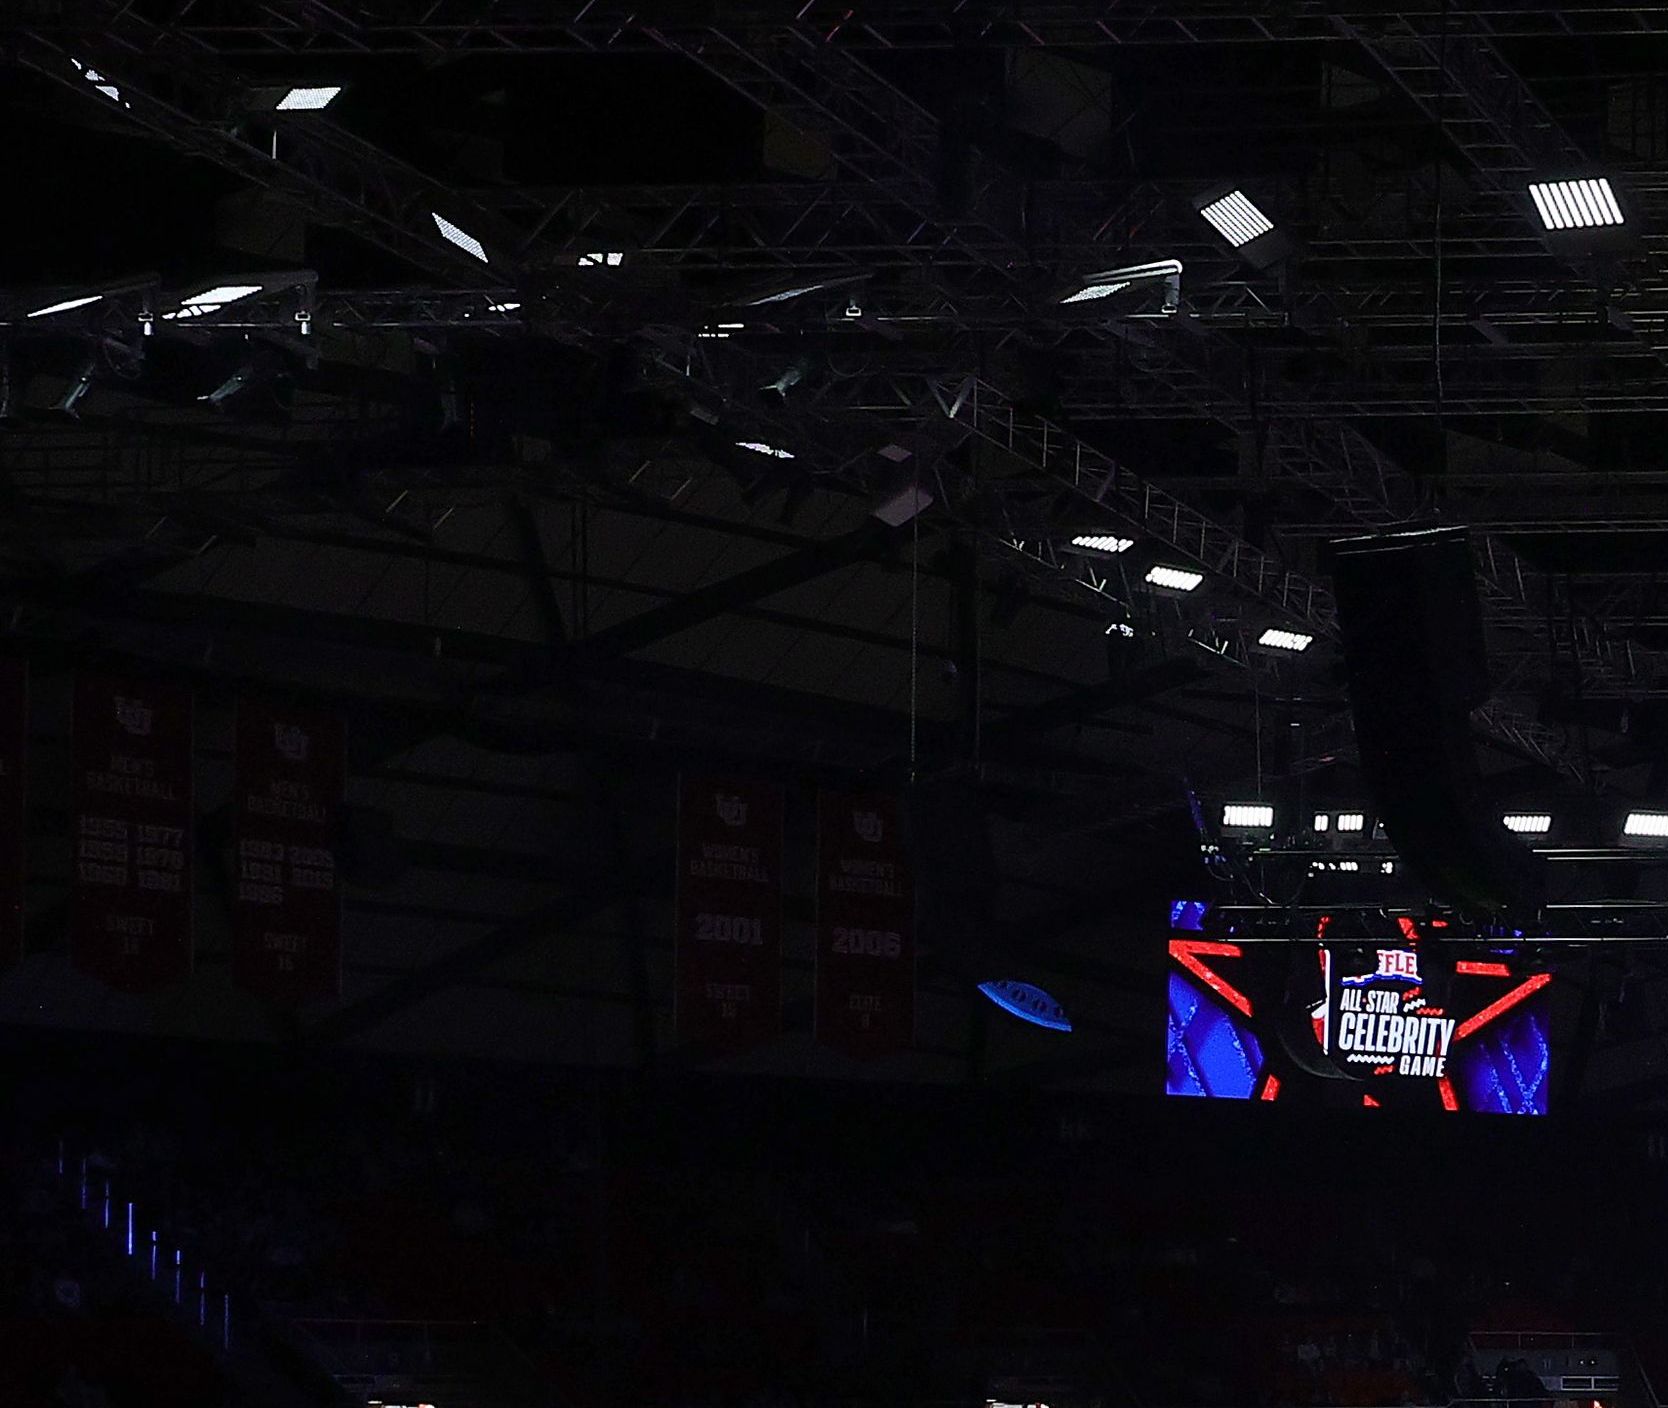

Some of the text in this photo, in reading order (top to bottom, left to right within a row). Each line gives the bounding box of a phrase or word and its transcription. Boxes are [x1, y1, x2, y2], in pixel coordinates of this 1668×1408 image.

[694, 912, 764, 946] 2001
[831, 926, 902, 960] 2006
[1339, 1011, 1455, 1057] CELEBRITY
[1399, 1056, 1446, 1078] GAME
